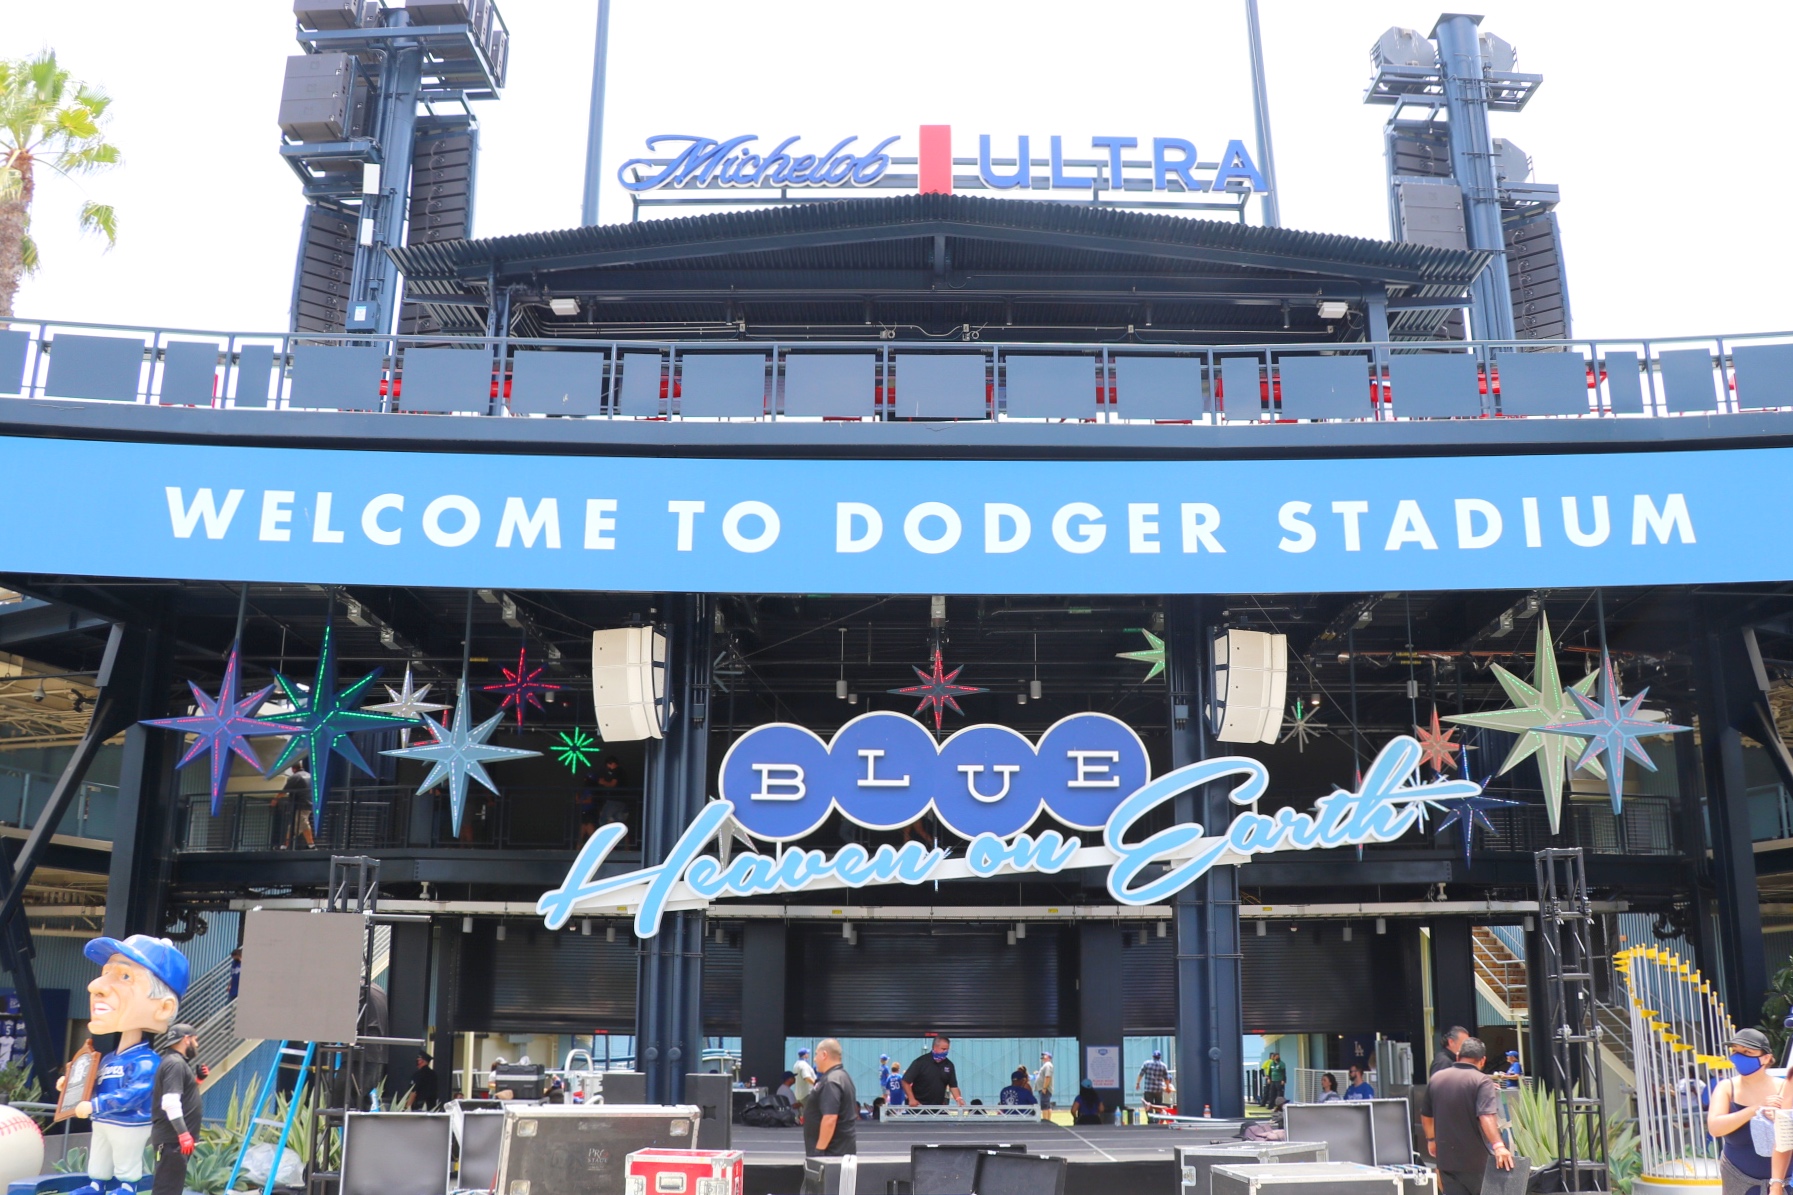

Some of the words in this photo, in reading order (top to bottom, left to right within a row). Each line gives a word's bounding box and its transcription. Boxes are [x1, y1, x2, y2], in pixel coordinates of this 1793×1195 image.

[617, 134, 901, 192] Michelob
[977, 134, 1269, 195] ULTRA
[166, 486, 618, 550] WELCOME
[668, 500, 781, 554] TO
[836, 501, 1227, 555] DODGER
[1278, 493, 1697, 554] STADIUM
[750, 748, 1121, 804] BLUE
[537, 799, 948, 939] Heaven
[965, 830, 1081, 878] on
[1105, 735, 1483, 906] Earth
[1354, 1041, 1364, 1056] LA
[889, 1081, 901, 1091] 50
